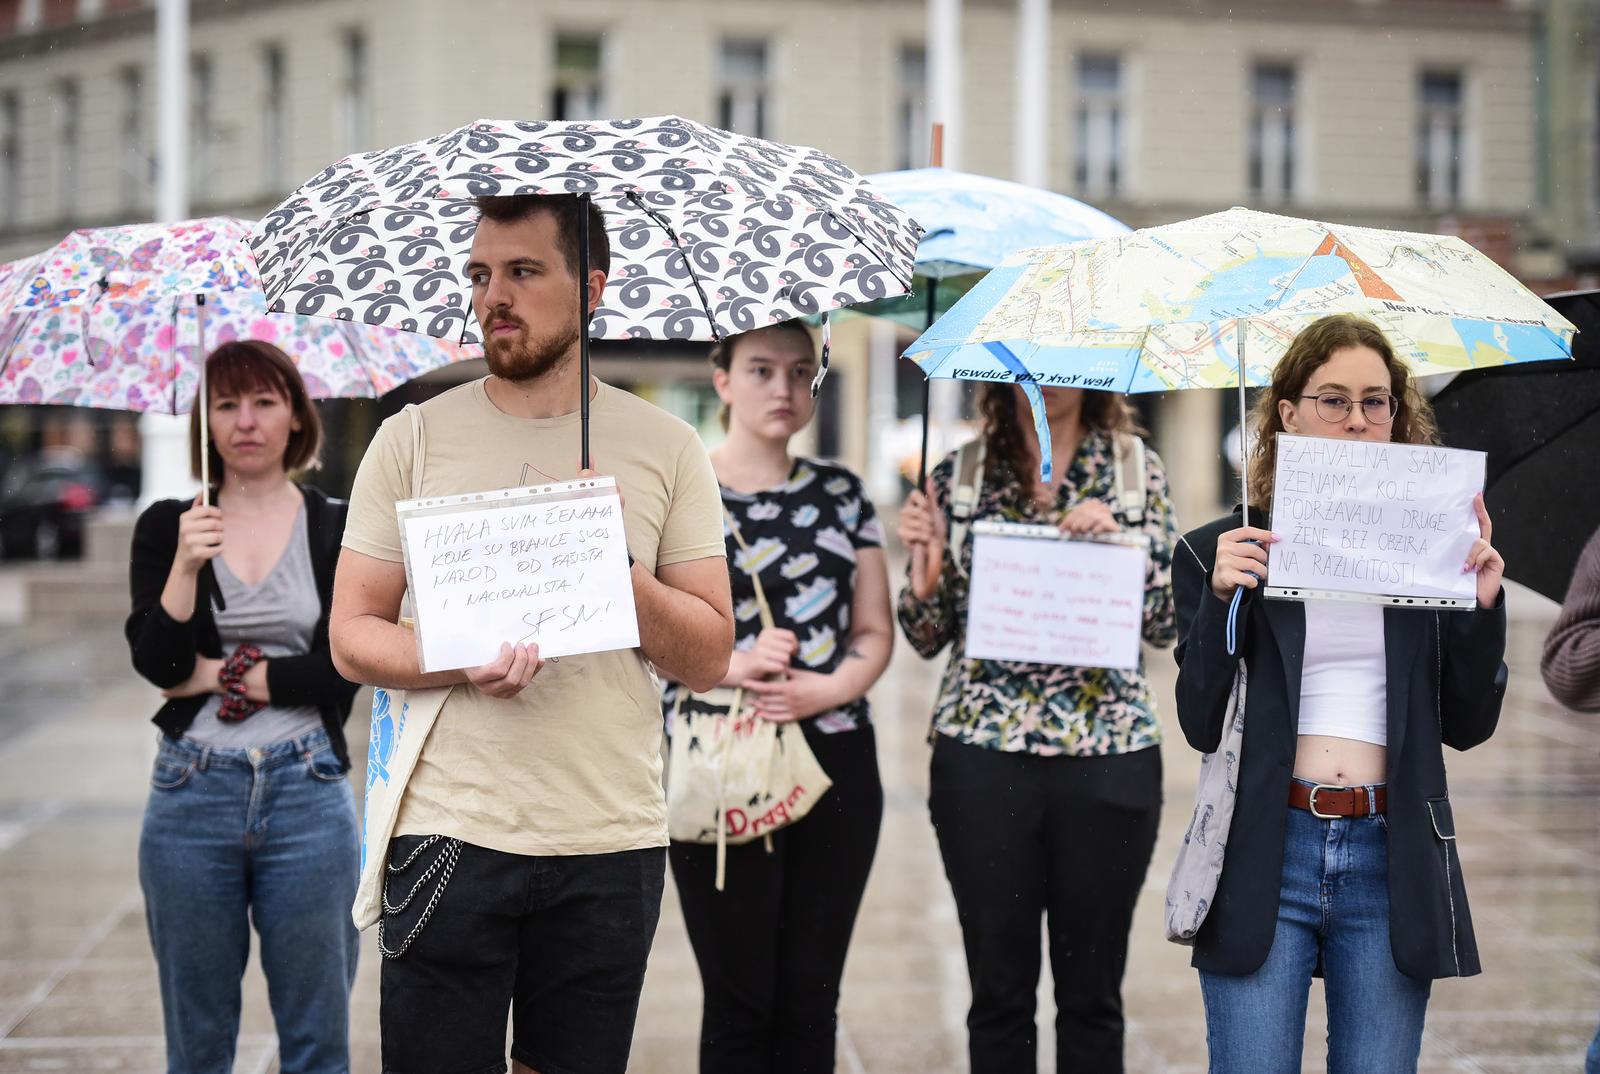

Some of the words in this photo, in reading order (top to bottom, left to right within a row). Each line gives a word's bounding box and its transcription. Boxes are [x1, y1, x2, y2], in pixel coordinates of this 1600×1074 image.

[1382, 301, 1417, 314] New
[1281, 439, 1391, 473] ZAHVALNA
[1407, 449, 1449, 477] SAM
[1282, 467, 1358, 500] ŽENAMA
[1376, 480, 1417, 502] KOJE
[423, 518, 491, 549] HVALA
[501, 513, 537, 531] SVIM
[545, 504, 613, 525] ŽENAMA
[1281, 494, 1384, 526] PODRŽAVAJU
[1401, 508, 1449, 532] DRUGE
[430, 548, 473, 569] KOJE
[482, 543, 503, 556] SU
[1292, 522, 1329, 548] ŽENE
[1341, 529, 1370, 551] BEZ
[1377, 531, 1428, 556] OBZIRA
[433, 565, 497, 589] NAROD
[517, 557, 542, 574] OD
[551, 547, 604, 569] FAŠISTA
[1278, 551, 1300, 575] NA
[1312, 553, 1417, 588] RAZLIČITOSTI
